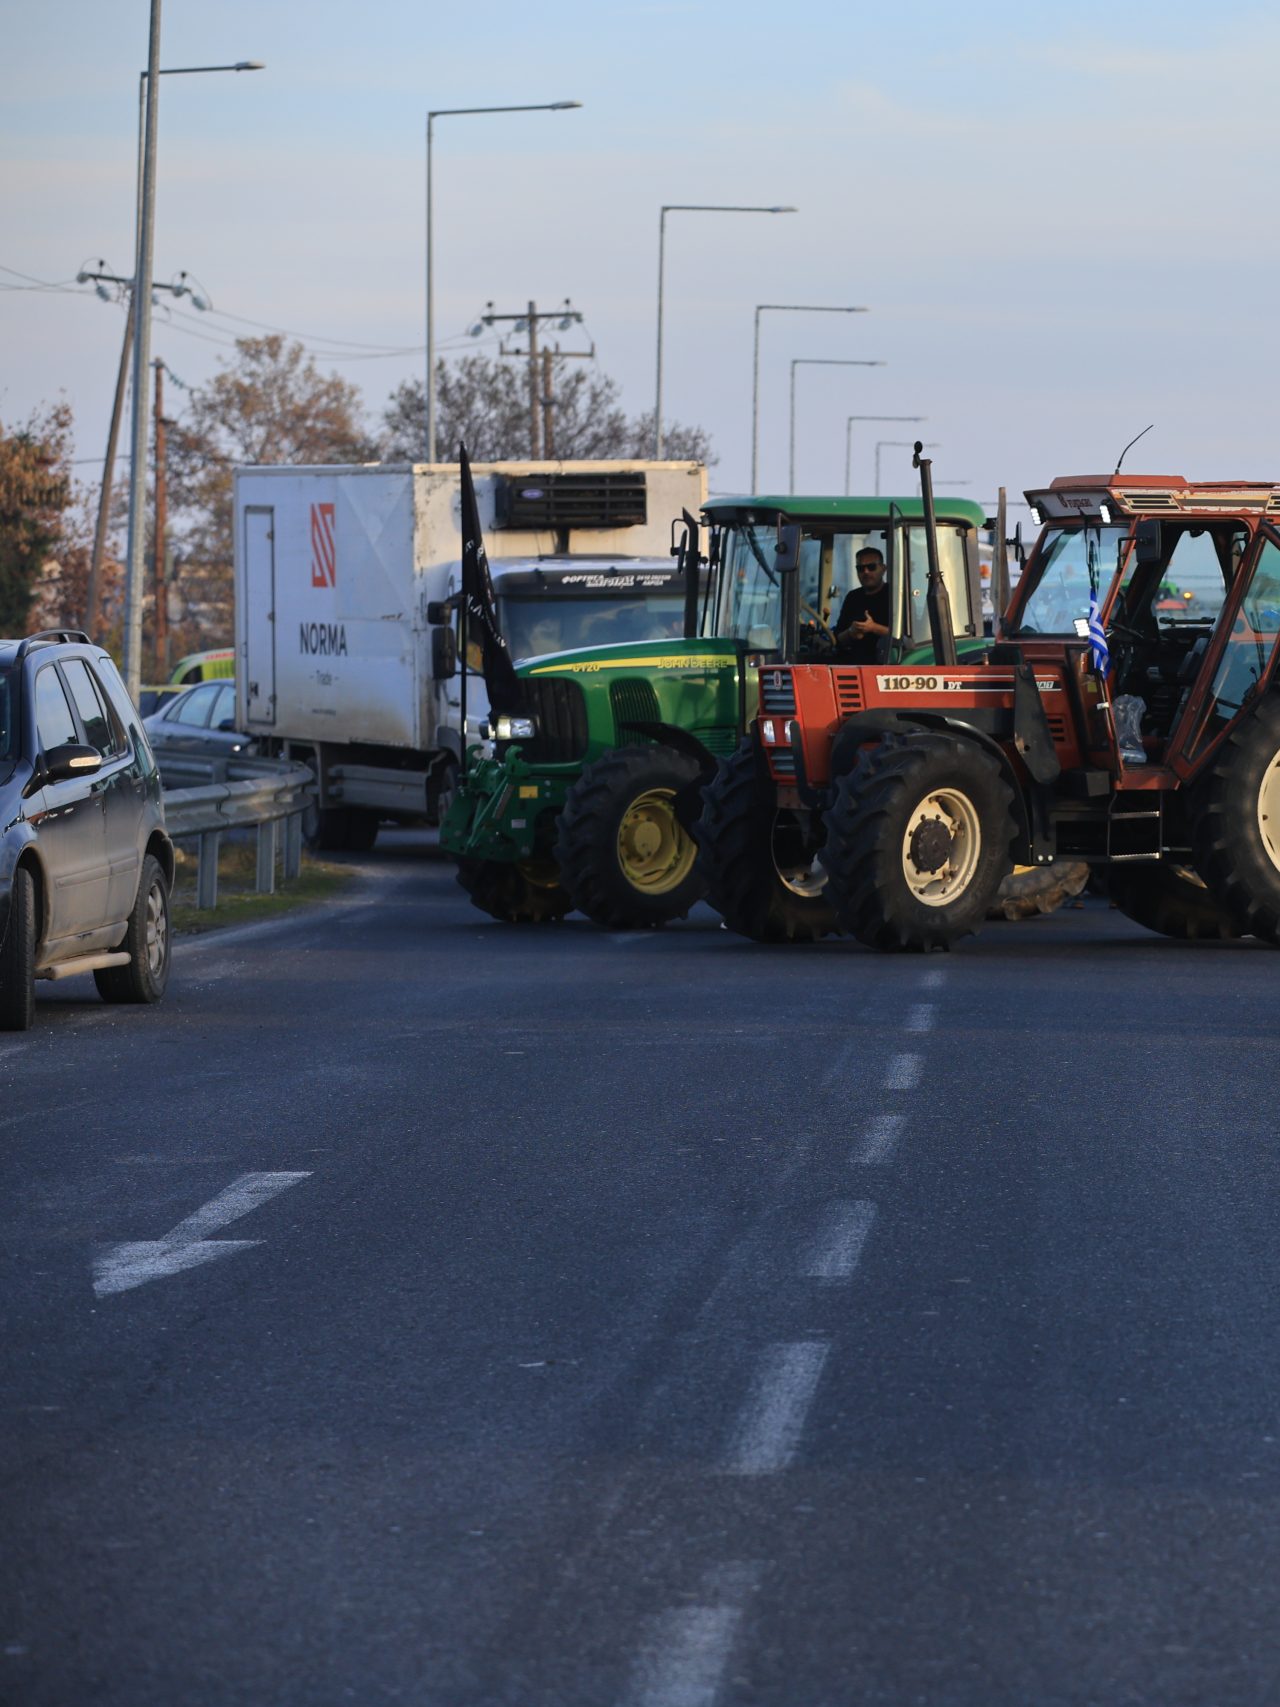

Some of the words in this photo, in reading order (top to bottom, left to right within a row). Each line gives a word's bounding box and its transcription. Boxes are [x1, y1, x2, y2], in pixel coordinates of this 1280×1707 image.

[299, 622, 348, 656] NORMA
[656, 657, 688, 668] JOHN
[690, 657, 728, 668] DEERE
[883, 676, 937, 690] 110-90
[948, 681, 962, 690] DT
